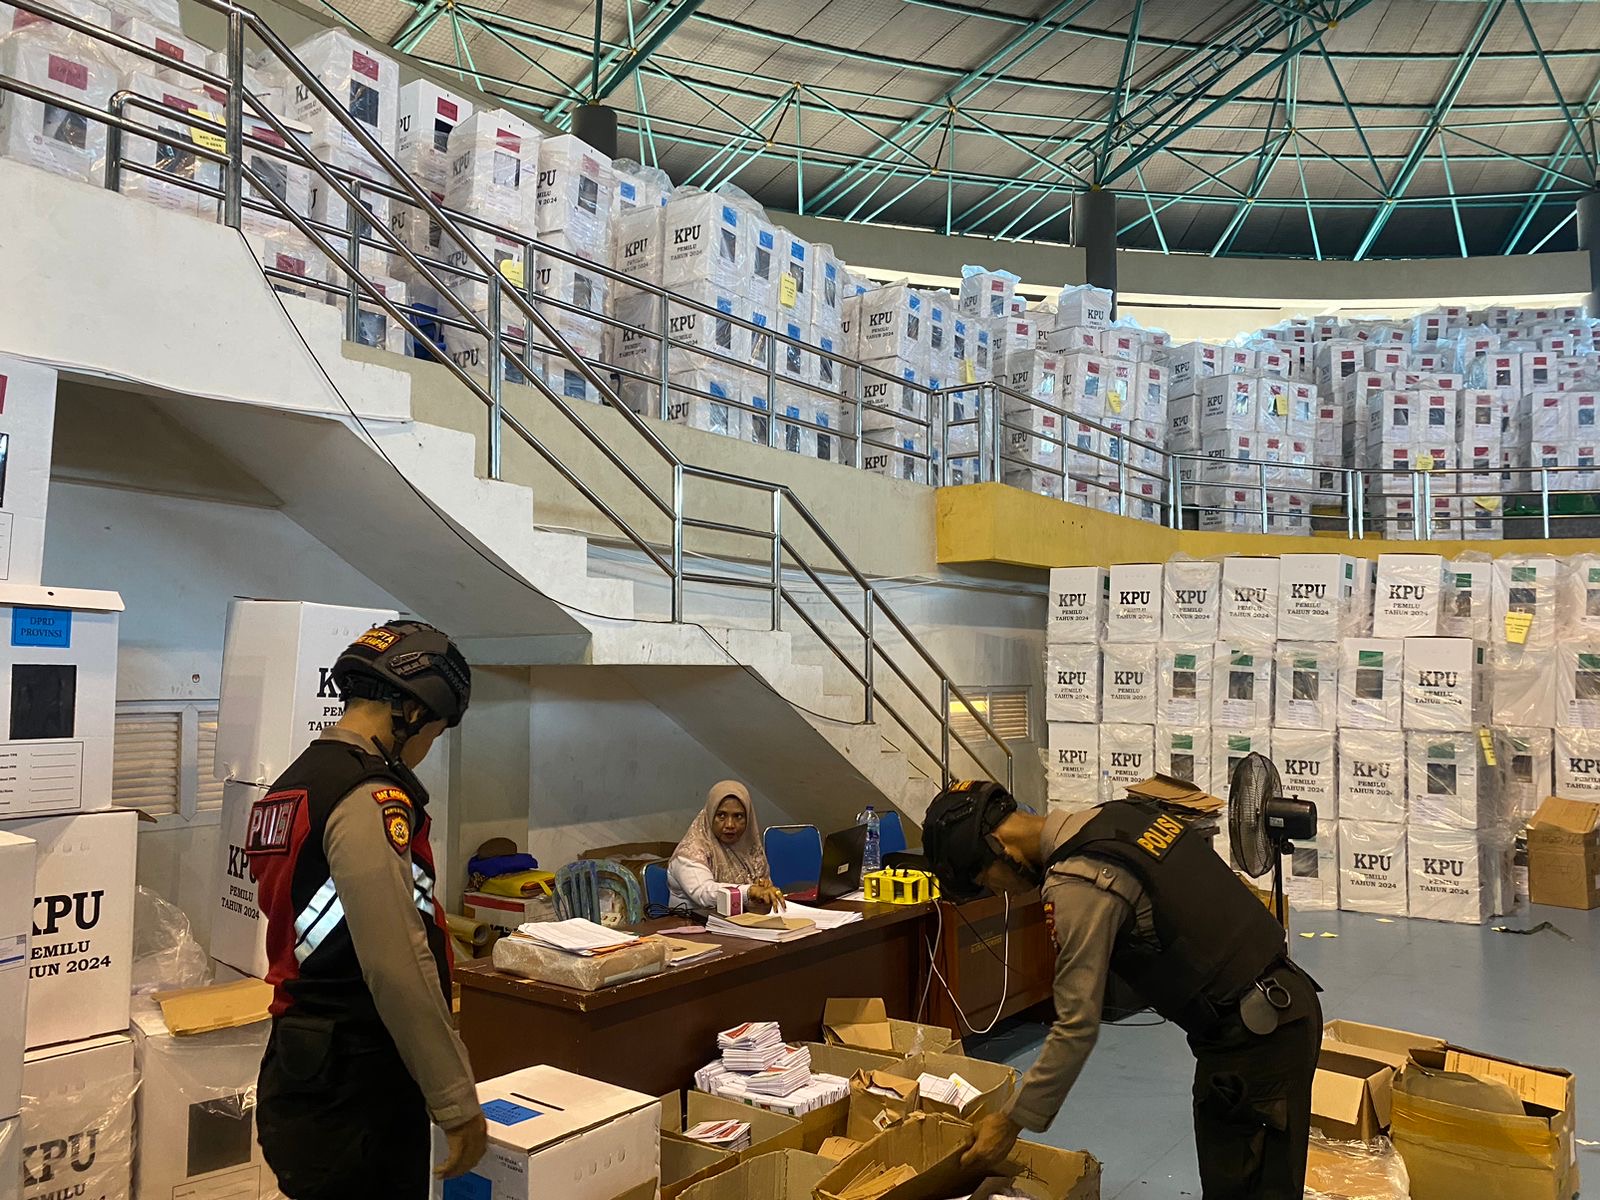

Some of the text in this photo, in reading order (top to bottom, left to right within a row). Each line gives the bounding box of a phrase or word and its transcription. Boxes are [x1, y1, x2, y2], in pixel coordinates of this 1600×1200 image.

[674, 224, 701, 244] KPU
[624, 237, 649, 258] KPU
[869, 311, 893, 326] KPU
[1087, 309, 1104, 320] KPU
[670, 314, 697, 333] KPU
[1174, 361, 1191, 375] KPU
[1012, 371, 1029, 385] KPU
[864, 383, 888, 398] KPU
[1207, 395, 1223, 407] KPU
[667, 402, 690, 420] KPU
[1173, 415, 1189, 428] KPU
[864, 455, 888, 470] KPU
[1120, 591, 1150, 604] KPU
[1175, 590, 1207, 604] KPU
[1233, 587, 1268, 603] KPU
[1291, 583, 1327, 599] KPU
[1389, 585, 1426, 600] KPU
[1059, 593, 1087, 607] KPU
[29, 616, 55, 626] DPRD
[21, 628, 62, 638] PROVINSI
[1057, 671, 1087, 685] KPU
[1114, 671, 1144, 685] KPU
[1419, 670, 1458, 688] KPU
[1059, 750, 1088, 764] KPU
[1111, 752, 1142, 768] KPU
[1285, 759, 1320, 776] KPU
[1353, 761, 1391, 778] KPU
[1282, 784, 1305, 792] TAHUN
[1349, 787, 1375, 795] TAHUN
[1357, 780, 1386, 788] PEMILU
[1136, 813, 1184, 857] POLISI
[1353, 853, 1392, 871] KPU
[1423, 857, 1464, 877] KPU
[1350, 879, 1378, 887] TAHUN
[1419, 885, 1470, 895] TAHUN 2024
[229, 884, 254, 902] PEMILU
[221, 896, 260, 921] TAHUN 2024
[67, 955, 112, 973] 2024
